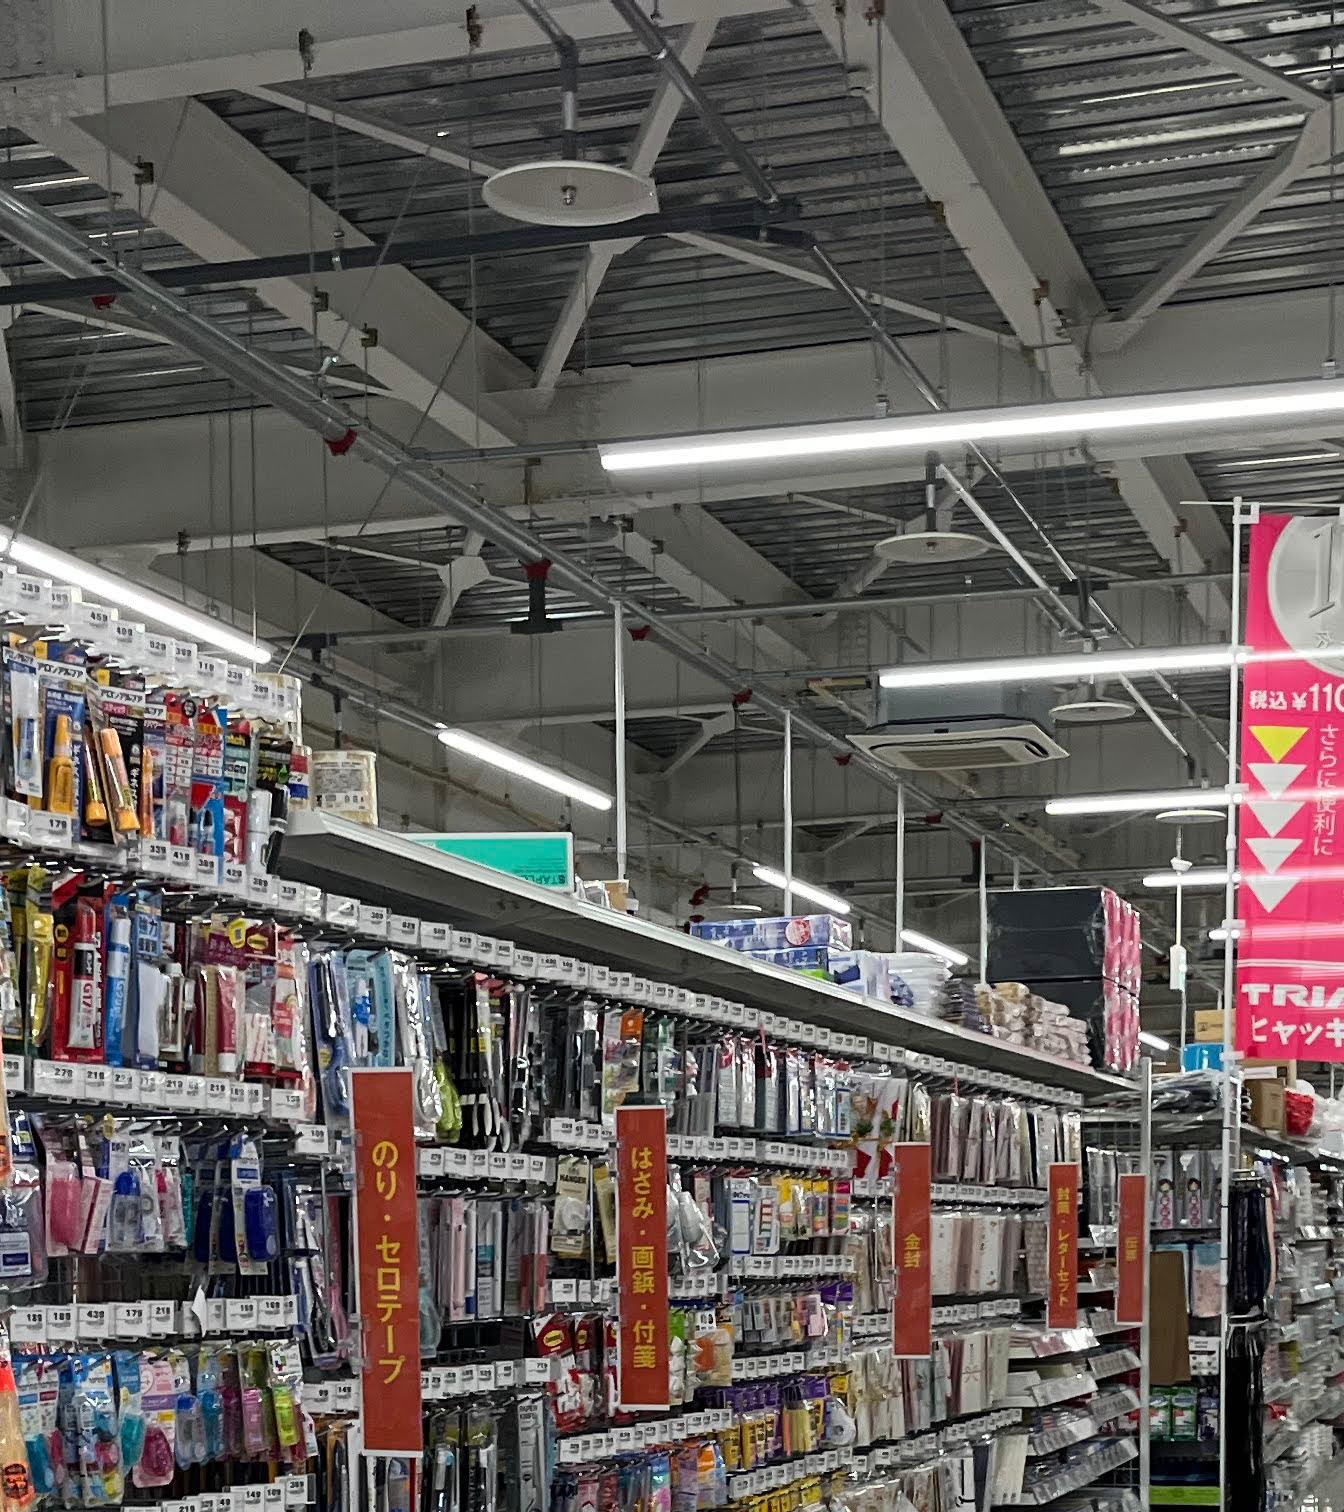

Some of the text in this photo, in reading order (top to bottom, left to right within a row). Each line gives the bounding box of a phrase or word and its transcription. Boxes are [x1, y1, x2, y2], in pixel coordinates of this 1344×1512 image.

[371, 1139, 404, 1385] のり・セロテープ
[904, 1233, 920, 1269] 金封
